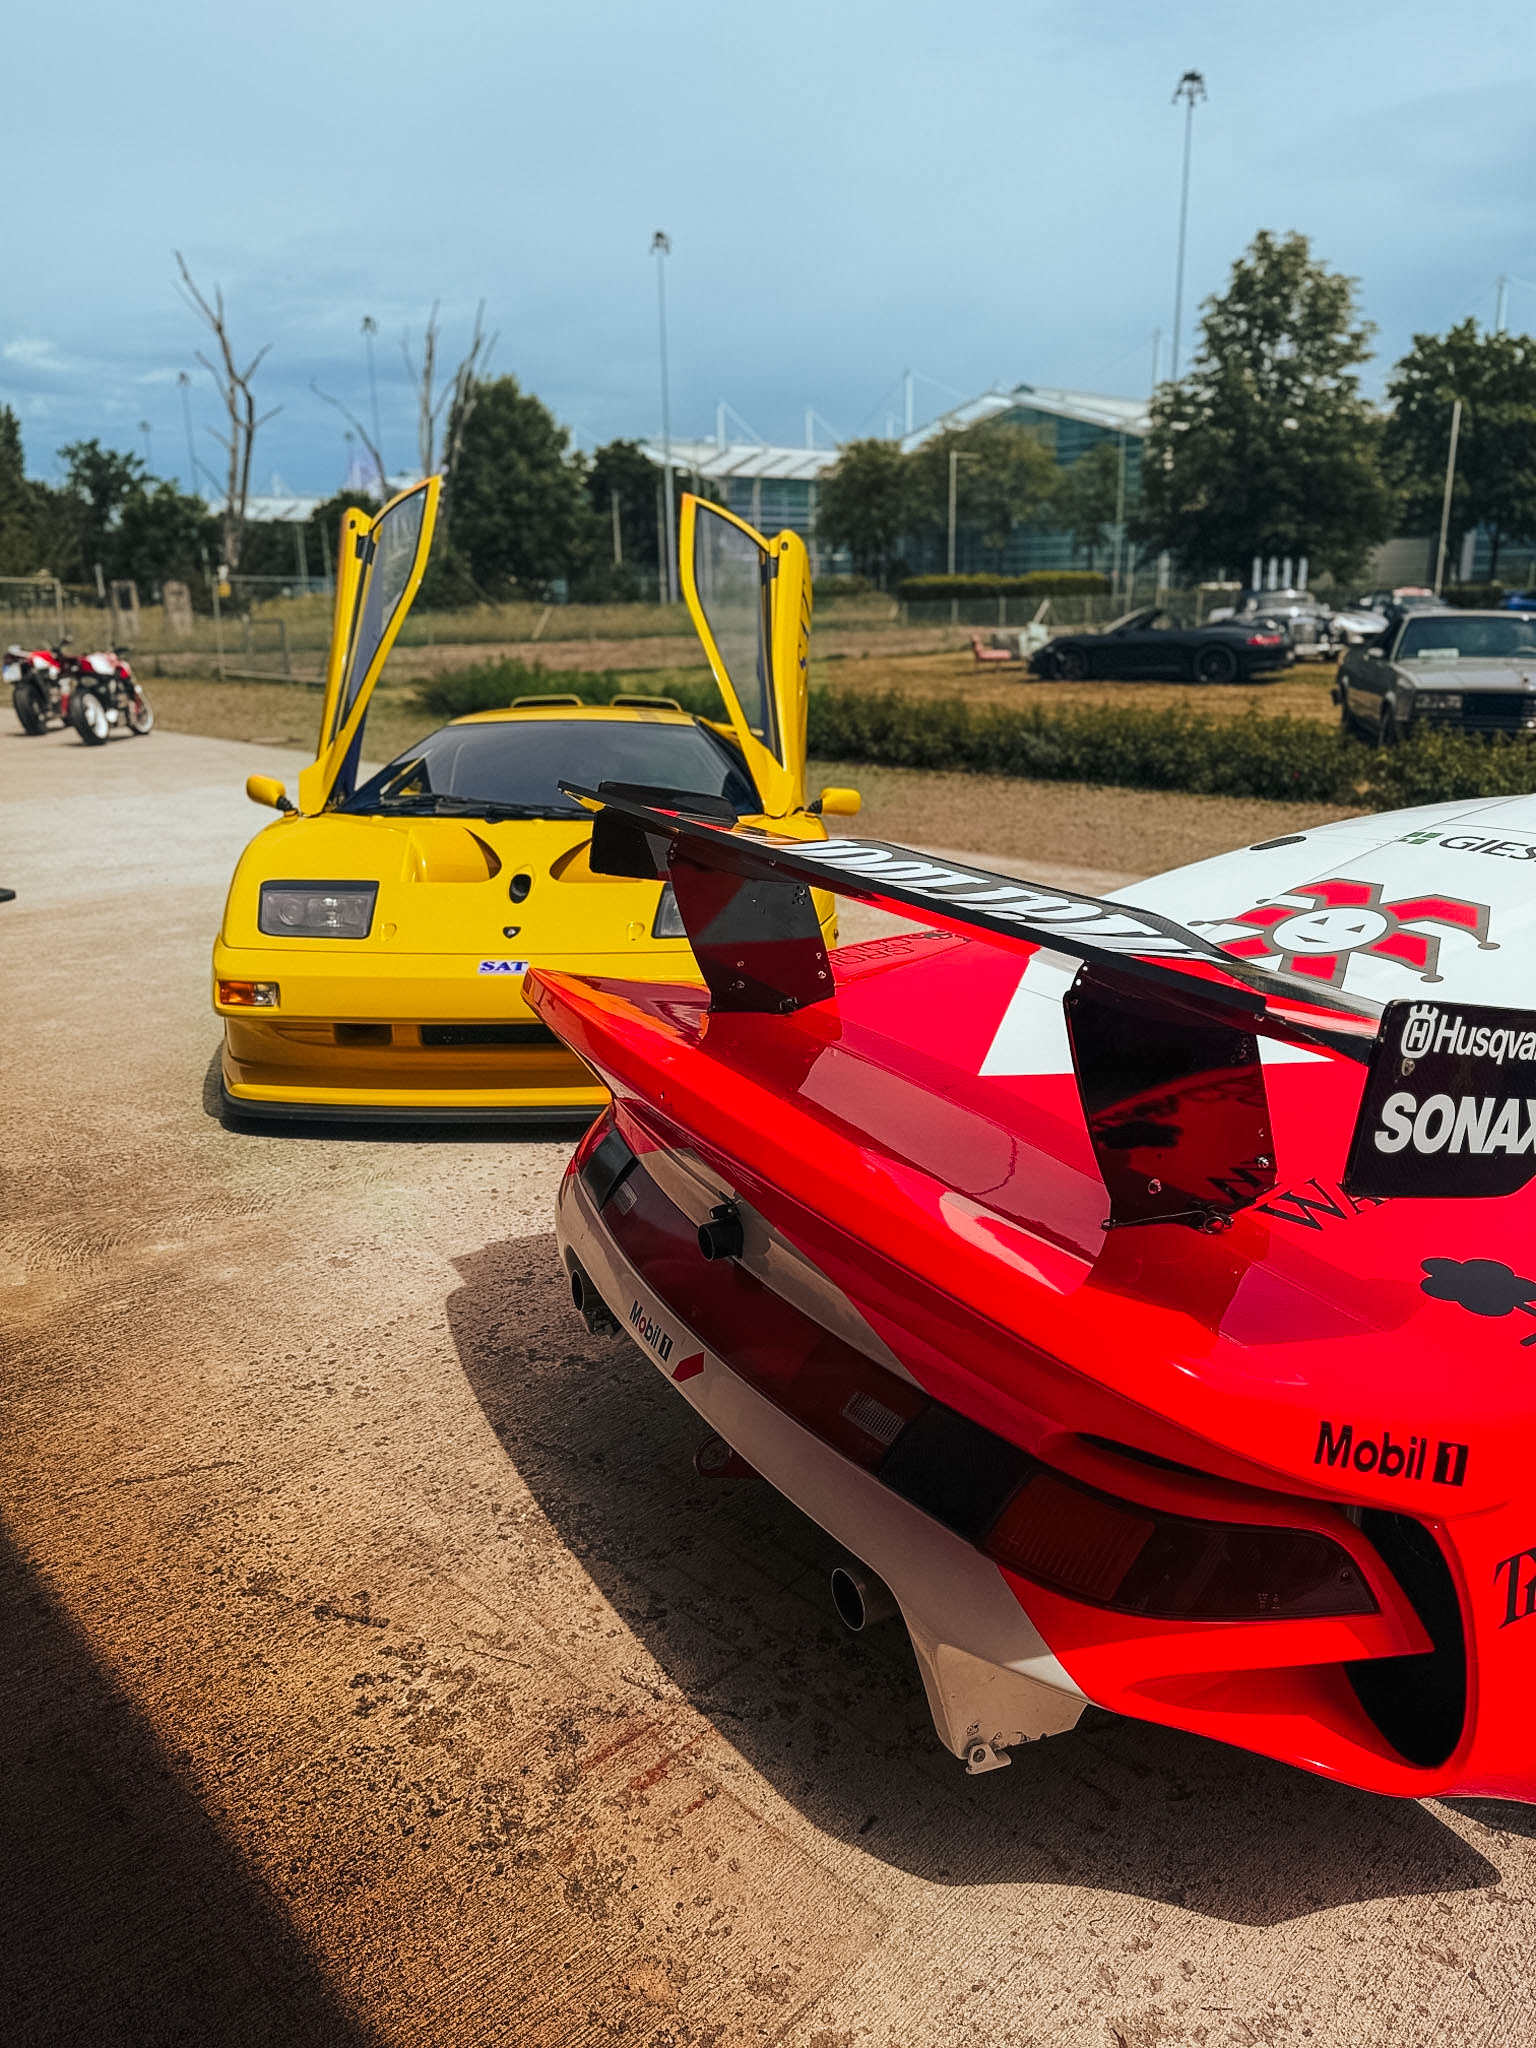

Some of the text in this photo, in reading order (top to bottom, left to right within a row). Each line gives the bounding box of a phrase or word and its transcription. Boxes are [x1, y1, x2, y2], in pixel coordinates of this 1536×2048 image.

[1439, 836, 1536, 862] GIES
[480, 961, 529, 971] SAT
[1433, 1015, 1536, 1065] Husqva
[629, 1299, 662, 1349] Mobil
[1314, 1420, 1427, 1480] Mobil
